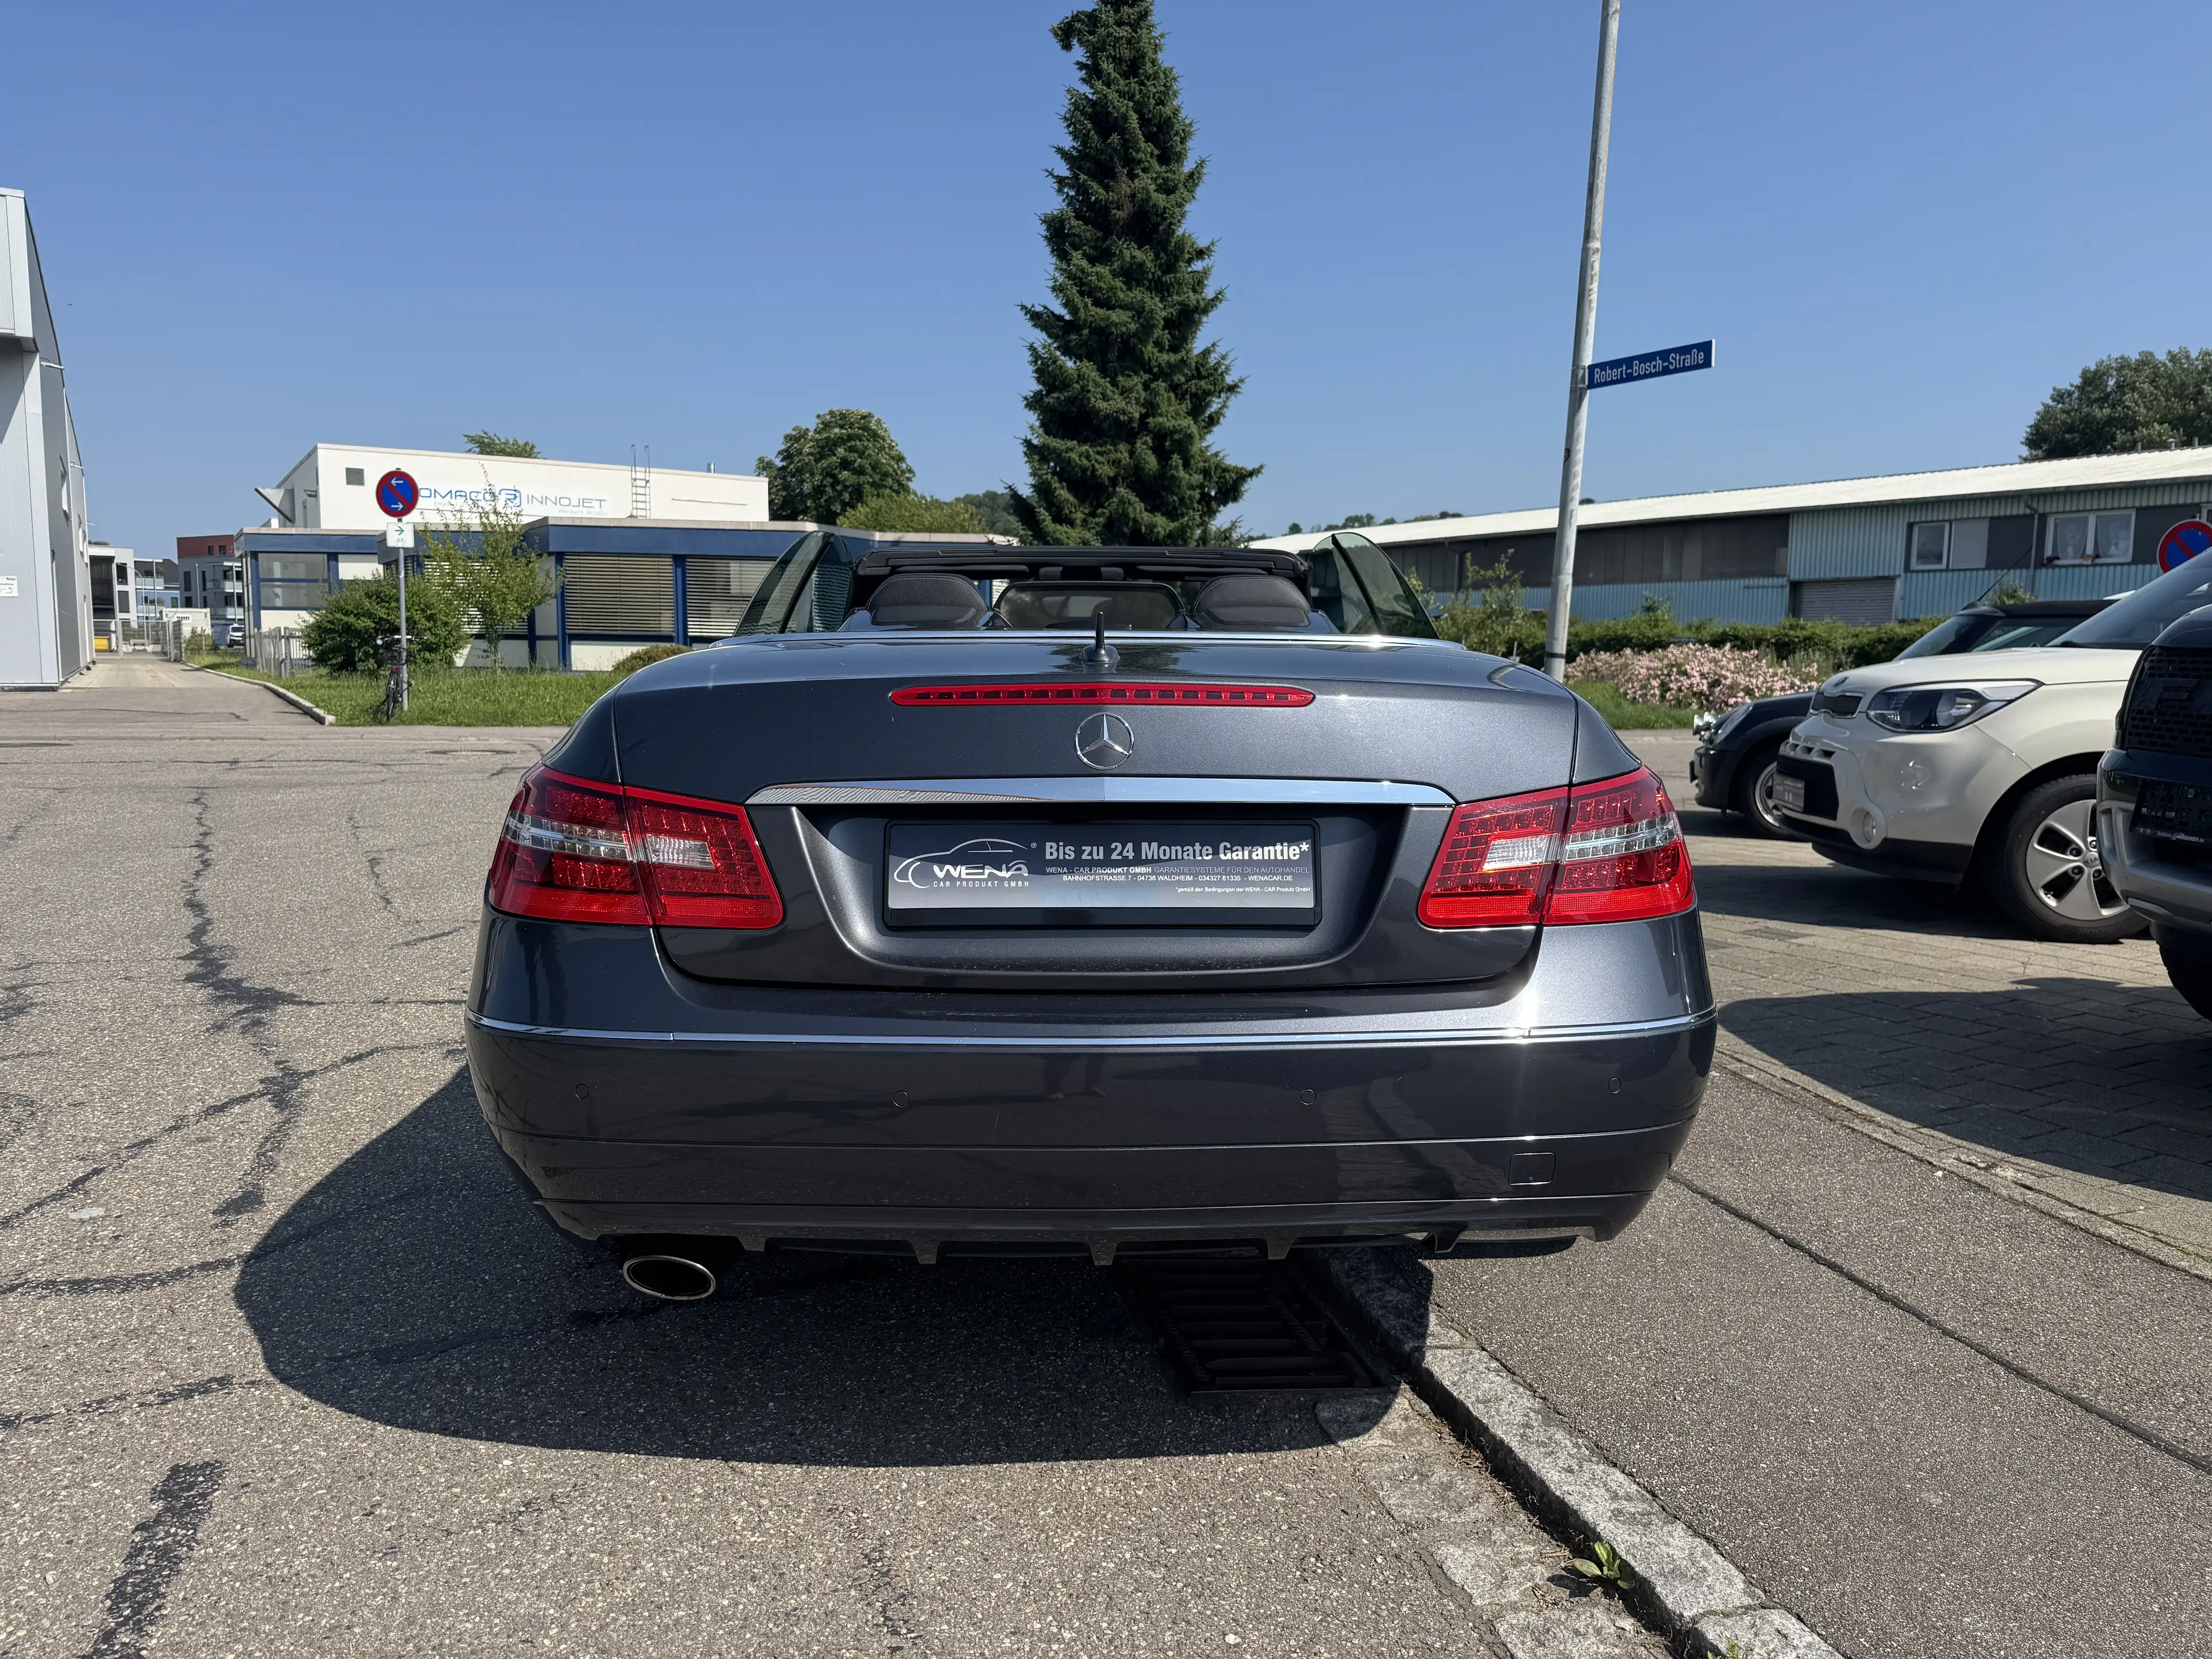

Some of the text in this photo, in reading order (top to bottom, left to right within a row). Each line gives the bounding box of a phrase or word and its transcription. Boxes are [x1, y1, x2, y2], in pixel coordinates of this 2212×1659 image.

[1594, 349, 1704, 384] Robert-Bosch-Straße
[419, 488, 496, 502] OMACO
[527, 494, 607, 509] INNOJET
[1046, 842, 1075, 859] Bis
[1081, 846, 1104, 859] zu
[1111, 842, 1134, 859] 24
[1141, 842, 1213, 859] Monate
[933, 862, 1029, 879] WENA
[1227, 865, 1242, 873] FÜR
